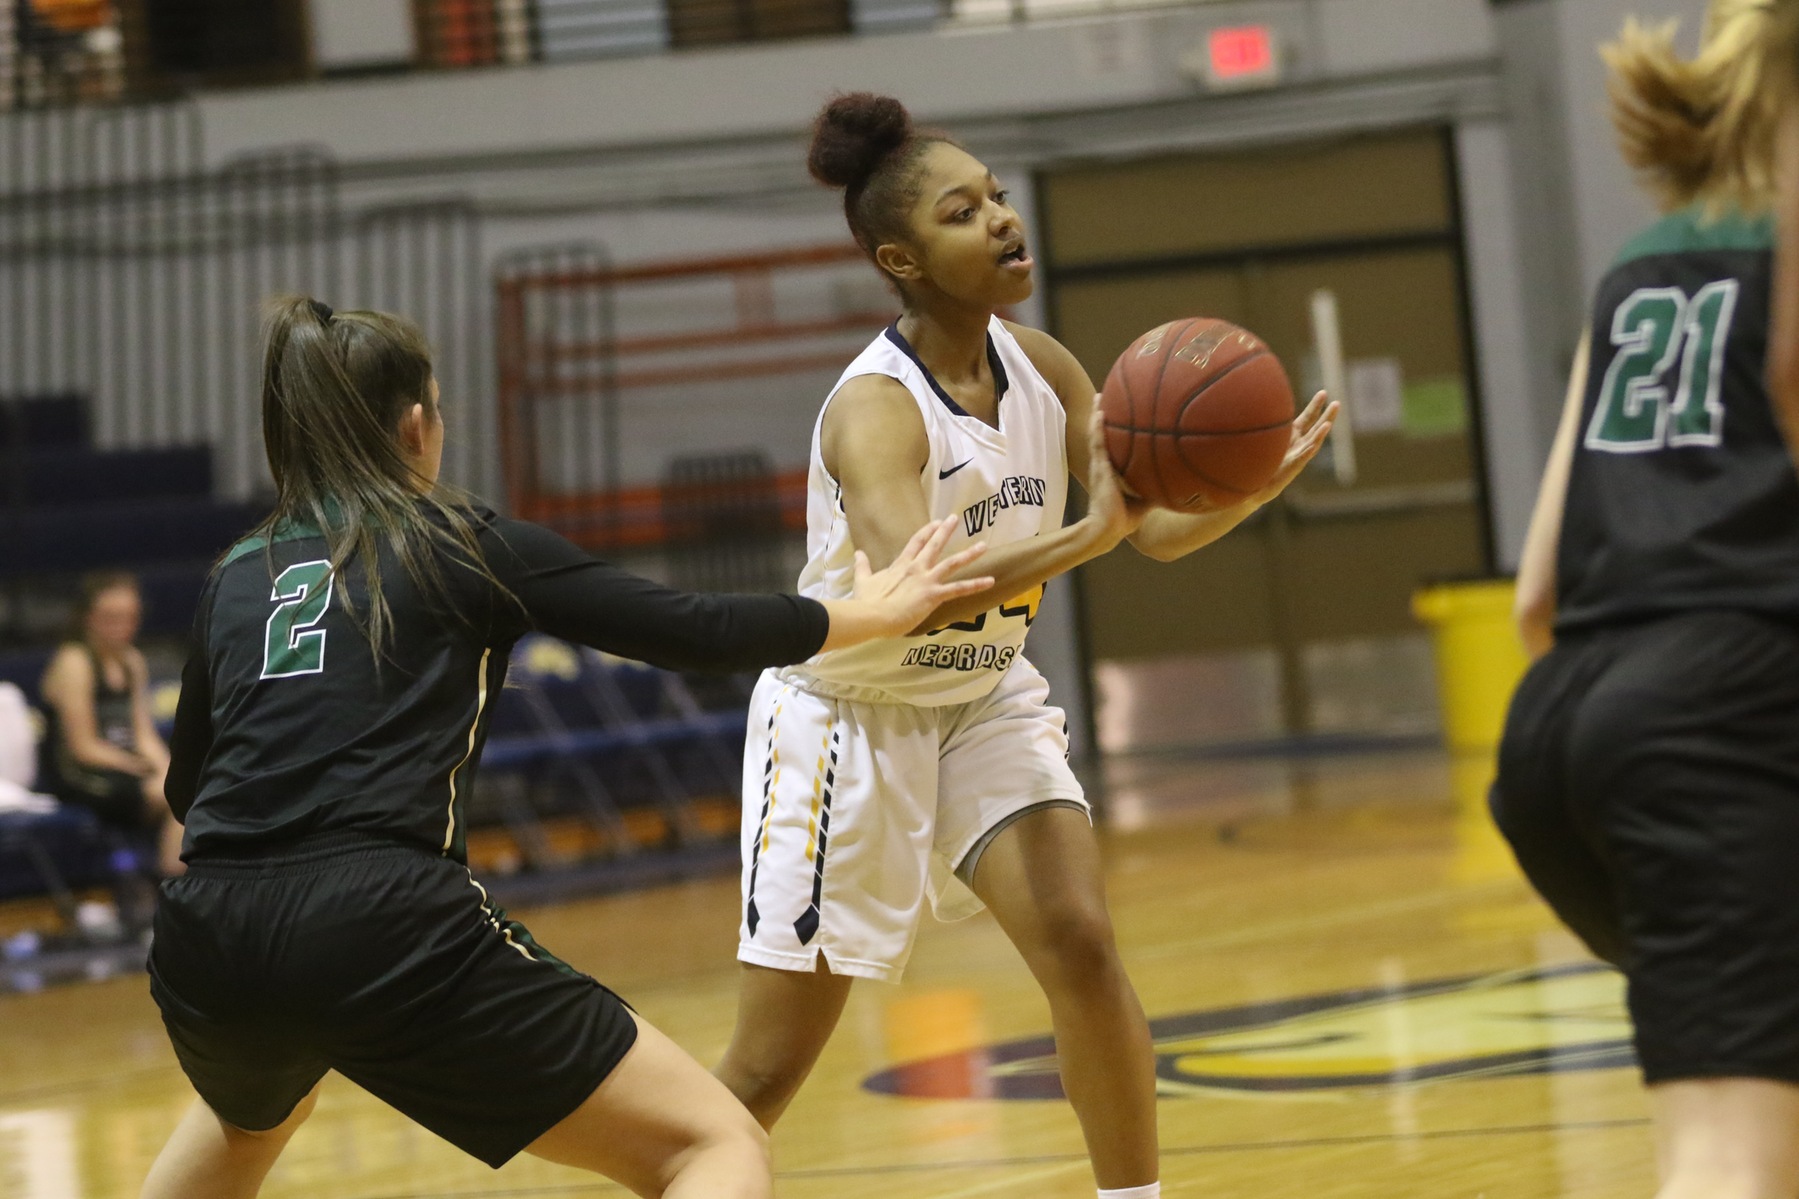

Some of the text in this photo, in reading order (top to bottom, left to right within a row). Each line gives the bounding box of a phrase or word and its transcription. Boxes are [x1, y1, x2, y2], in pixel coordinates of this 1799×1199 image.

[1584, 278, 1739, 454] 21
[963, 475, 1046, 537] WETERN
[259, 558, 336, 681] 2
[901, 643, 1022, 672] NEBRAS
